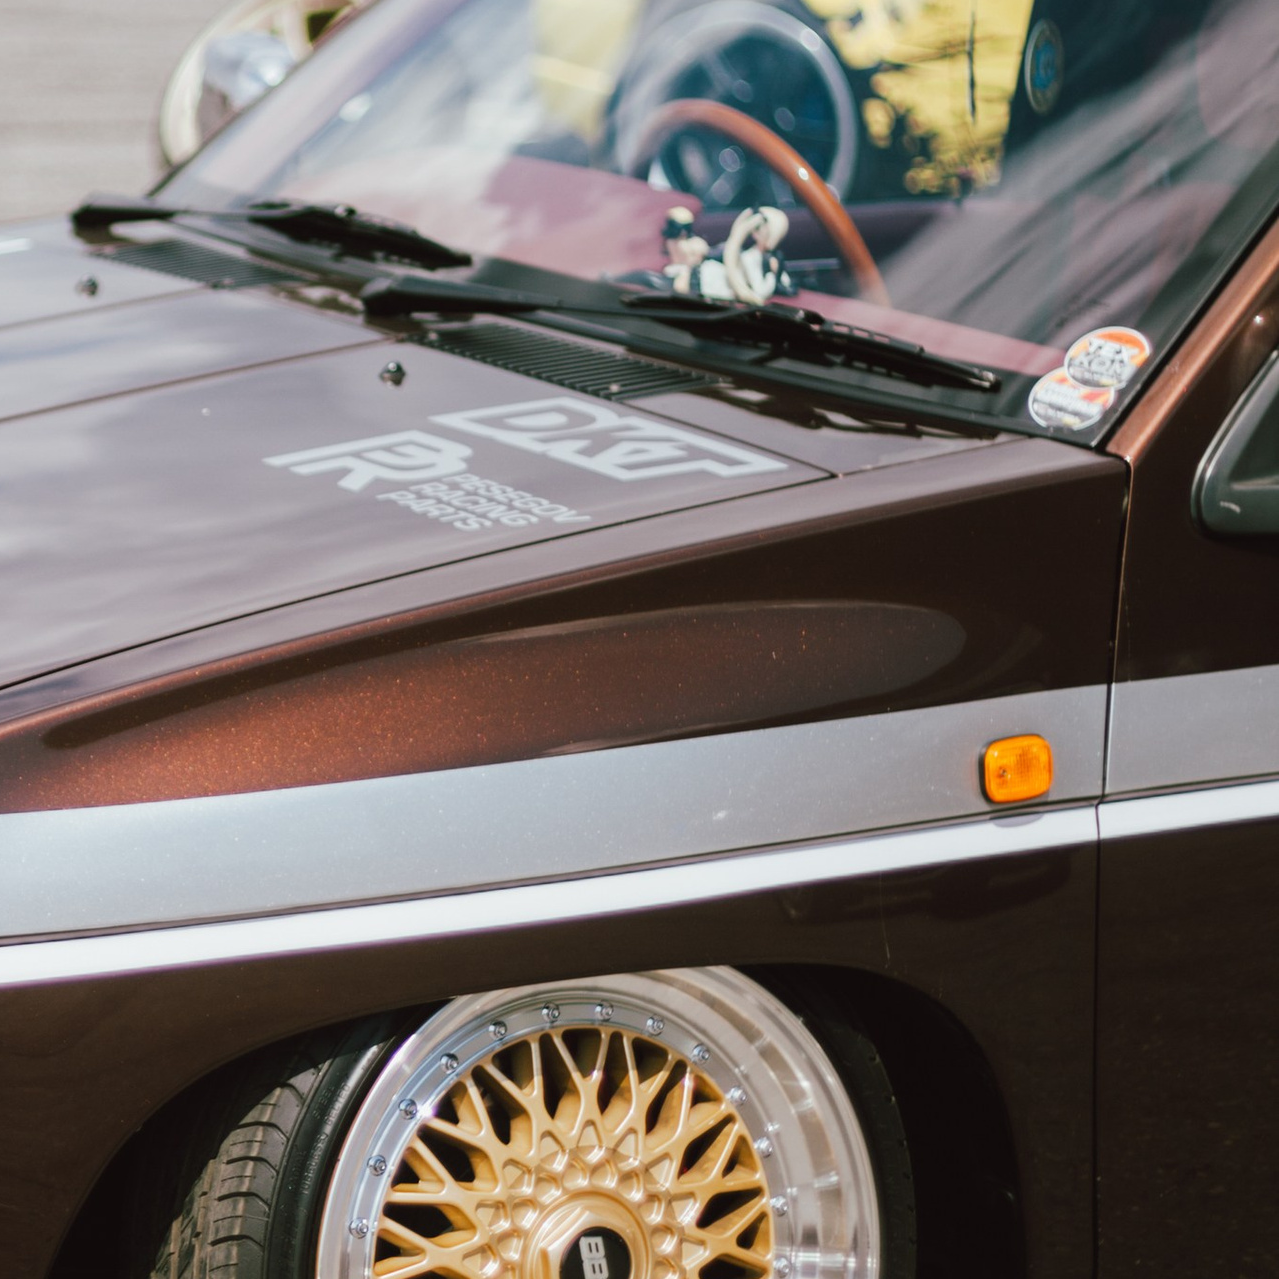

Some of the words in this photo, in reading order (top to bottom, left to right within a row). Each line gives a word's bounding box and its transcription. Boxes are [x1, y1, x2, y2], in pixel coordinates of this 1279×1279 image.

[427, 396, 789, 482] DKT
[376, 491, 493, 532] PARTS
[408, 482, 541, 528] RACING
[440, 473, 592, 524] PESEGOV
